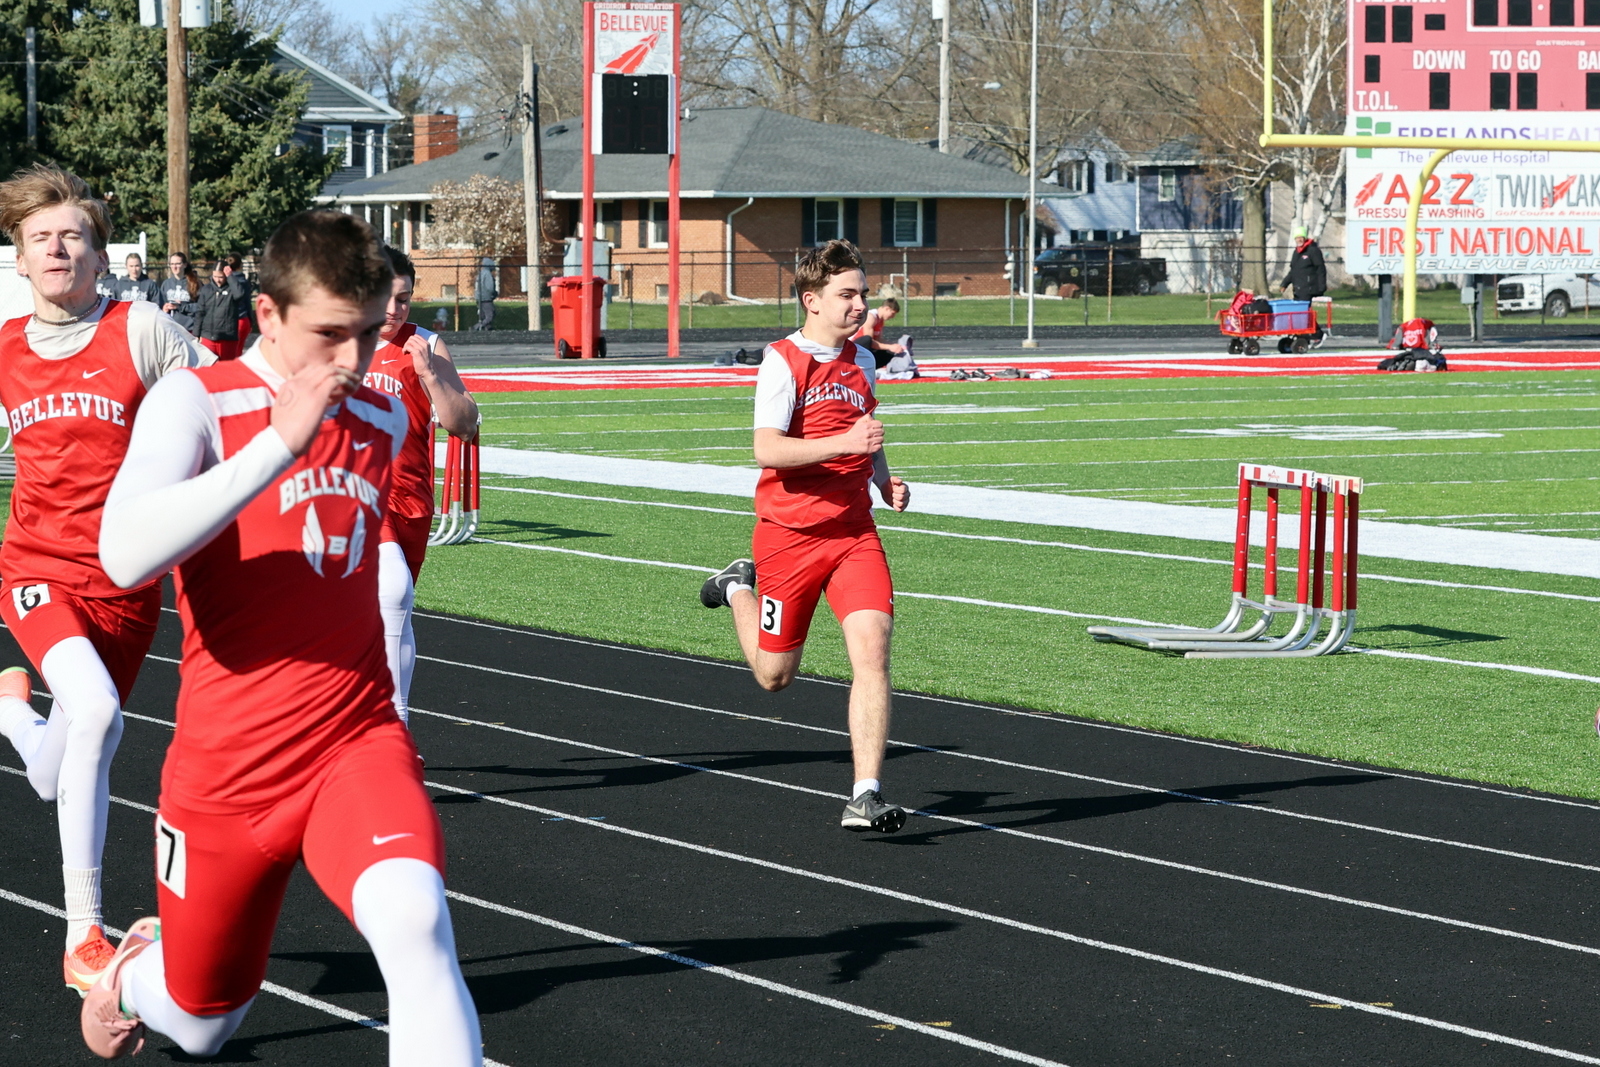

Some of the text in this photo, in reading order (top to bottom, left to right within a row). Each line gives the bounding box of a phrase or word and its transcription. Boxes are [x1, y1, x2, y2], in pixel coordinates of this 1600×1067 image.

[600, 12, 668, 32] BELLEVUE
[1412, 50, 1466, 70] DOWN
[1490, 50, 1541, 70] TO GO
[1356, 91, 1398, 110] T.O.L.
[1398, 150, 1550, 167] The llevue Hospital
[1384, 174, 1474, 205] A2Z
[1495, 174, 1555, 208] TWIN
[1358, 208, 1485, 218] PRESSUE WASHING
[1363, 226, 1593, 257] FIRST NATIONAL
[1368, 258, 1402, 271] AT
[795, 382, 866, 414] BELLEVUE
[9, 392, 126, 436] BELLEVUE
[279, 466, 382, 520] BELLEVUE
[328, 535, 348, 555] B
[20, 584, 41, 612] 6
[763, 599, 776, 631] 3
[161, 823, 176, 883] 7
